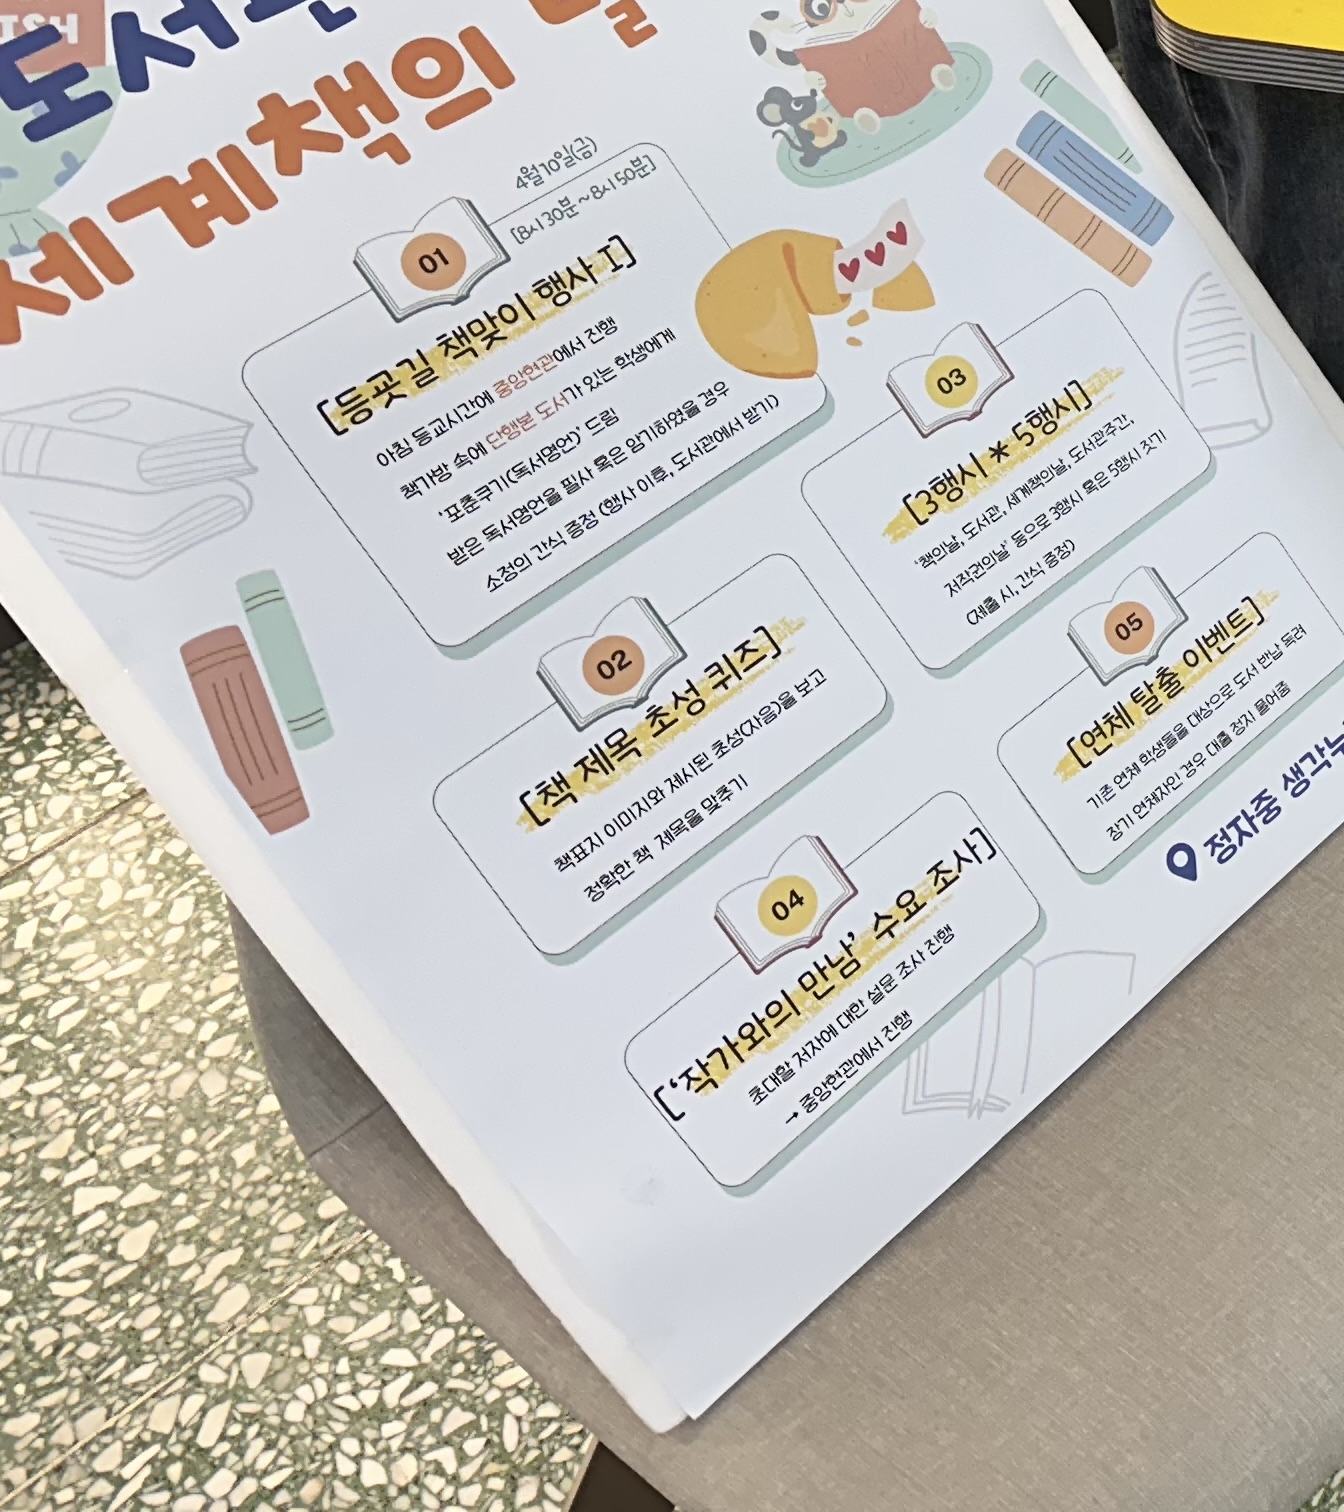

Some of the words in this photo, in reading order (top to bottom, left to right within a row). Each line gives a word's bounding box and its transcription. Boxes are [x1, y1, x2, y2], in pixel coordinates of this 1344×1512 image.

[419, 249, 450, 275] 01
[316, 348, 439, 436] [등굣길
[435, 292, 536, 360] 책맞이
[531, 255, 598, 307] 행사
[375, 436, 414, 467] 아침
[582, 314, 618, 345] 진행
[936, 368, 967, 394] 03
[398, 461, 453, 500] 책가방
[452, 440, 489, 470] 속에
[533, 382, 584, 421] 도서가
[581, 365, 618, 393] 있는
[613, 326, 677, 370] 학생에게
[445, 535, 485, 567] 받은
[559, 465, 595, 495] 필사
[592, 445, 629, 473] 혹은
[696, 380, 730, 407] 경우
[583, 406, 620, 437] 드림
[901, 451, 988, 526] [3행시
[1010, 379, 1092, 447] 5행시]
[486, 551, 533, 593] 소정의
[528, 529, 568, 561] 간식
[562, 508, 599, 540] 증정
[597, 484, 637, 517] (행사
[669, 415, 745, 472] 도서관에서
[740, 393, 779, 425] 받기)
[1009, 511, 1052, 548] 등으로
[1047, 488, 1084, 521] 3행시
[1081, 470, 1111, 495] 혹은
[1106, 446, 1142, 478] 5행시
[1138, 428, 1167, 455] 짓기
[1013, 560, 1046, 589] 간식
[1115, 612, 1144, 642] 05
[518, 770, 578, 827] [책
[572, 727, 642, 782] 제목
[644, 678, 706, 738] 초성
[703, 625, 782, 690] 퀴즈]
[596, 649, 633, 680] 02
[1065, 700, 1135, 768] [연체
[1129, 665, 1185, 716] 탈출
[1182, 595, 1265, 667] 이벤트]
[1085, 783, 1117, 809] 기존
[1112, 760, 1142, 790] 연체
[1185, 681, 1236, 728] 대상으로
[1231, 662, 1260, 690] 도서
[1255, 642, 1284, 670] 반납
[1279, 622, 1307, 648] 독려
[552, 830, 605, 873] 책표지
[602, 785, 666, 838] 이미지와
[662, 750, 714, 794] 제시된
[792, 667, 827, 698] 보고
[1105, 812, 1135, 842] 장기
[1131, 770, 1184, 820] 연체자인
[1178, 751, 1207, 779] 경우
[1228, 709, 1256, 736] 정지
[1202, 787, 1282, 864] 정자중
[582, 858, 635, 903] 정확한
[631, 843, 654, 865] 책
[652, 807, 705, 851] 제목을
[699, 772, 748, 816] 맞추기
[873, 889, 927, 940] 수요
[925, 826, 996, 895] 조사]
[771, 889, 806, 921] 04
[747, 1059, 796, 1106] 초대할
[790, 1022, 839, 1068] 저자에
[834, 997, 869, 1030] 대한
[866, 972, 899, 1005] 설문
[894, 948, 926, 980] 조사
[922, 922, 955, 956] 진행
[798, 1035, 884, 1114] 중앙현관에서
[879, 1009, 913, 1042] 진행
